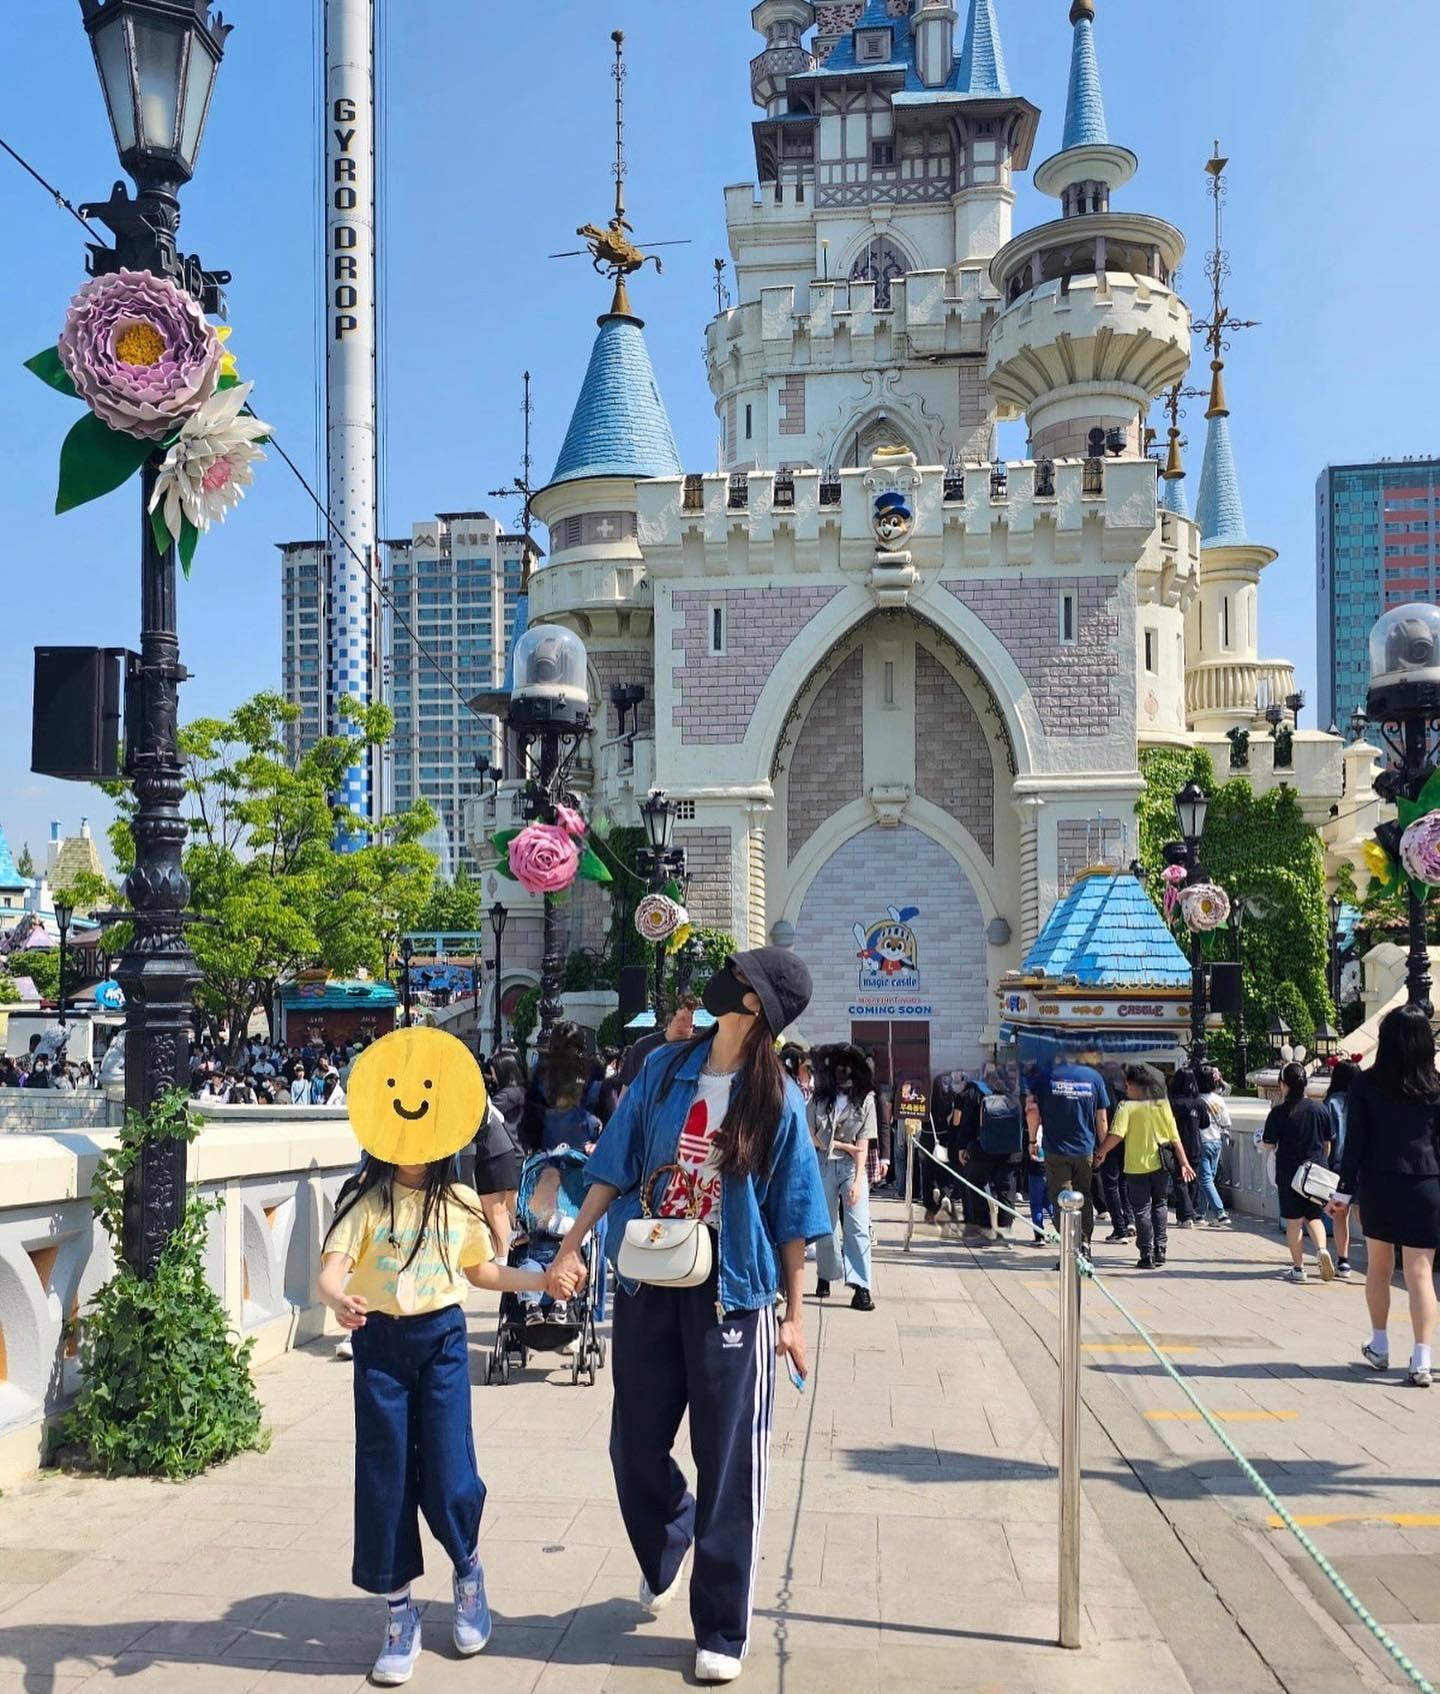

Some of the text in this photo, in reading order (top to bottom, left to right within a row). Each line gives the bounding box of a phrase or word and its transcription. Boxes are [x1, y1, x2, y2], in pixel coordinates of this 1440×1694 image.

[333, 98, 358, 340] GYRO DROP
[863, 976, 917, 989] magic castle
[848, 1006, 932, 1014] COMING SOON
[1117, 1004, 1165, 1017] CASTLE
